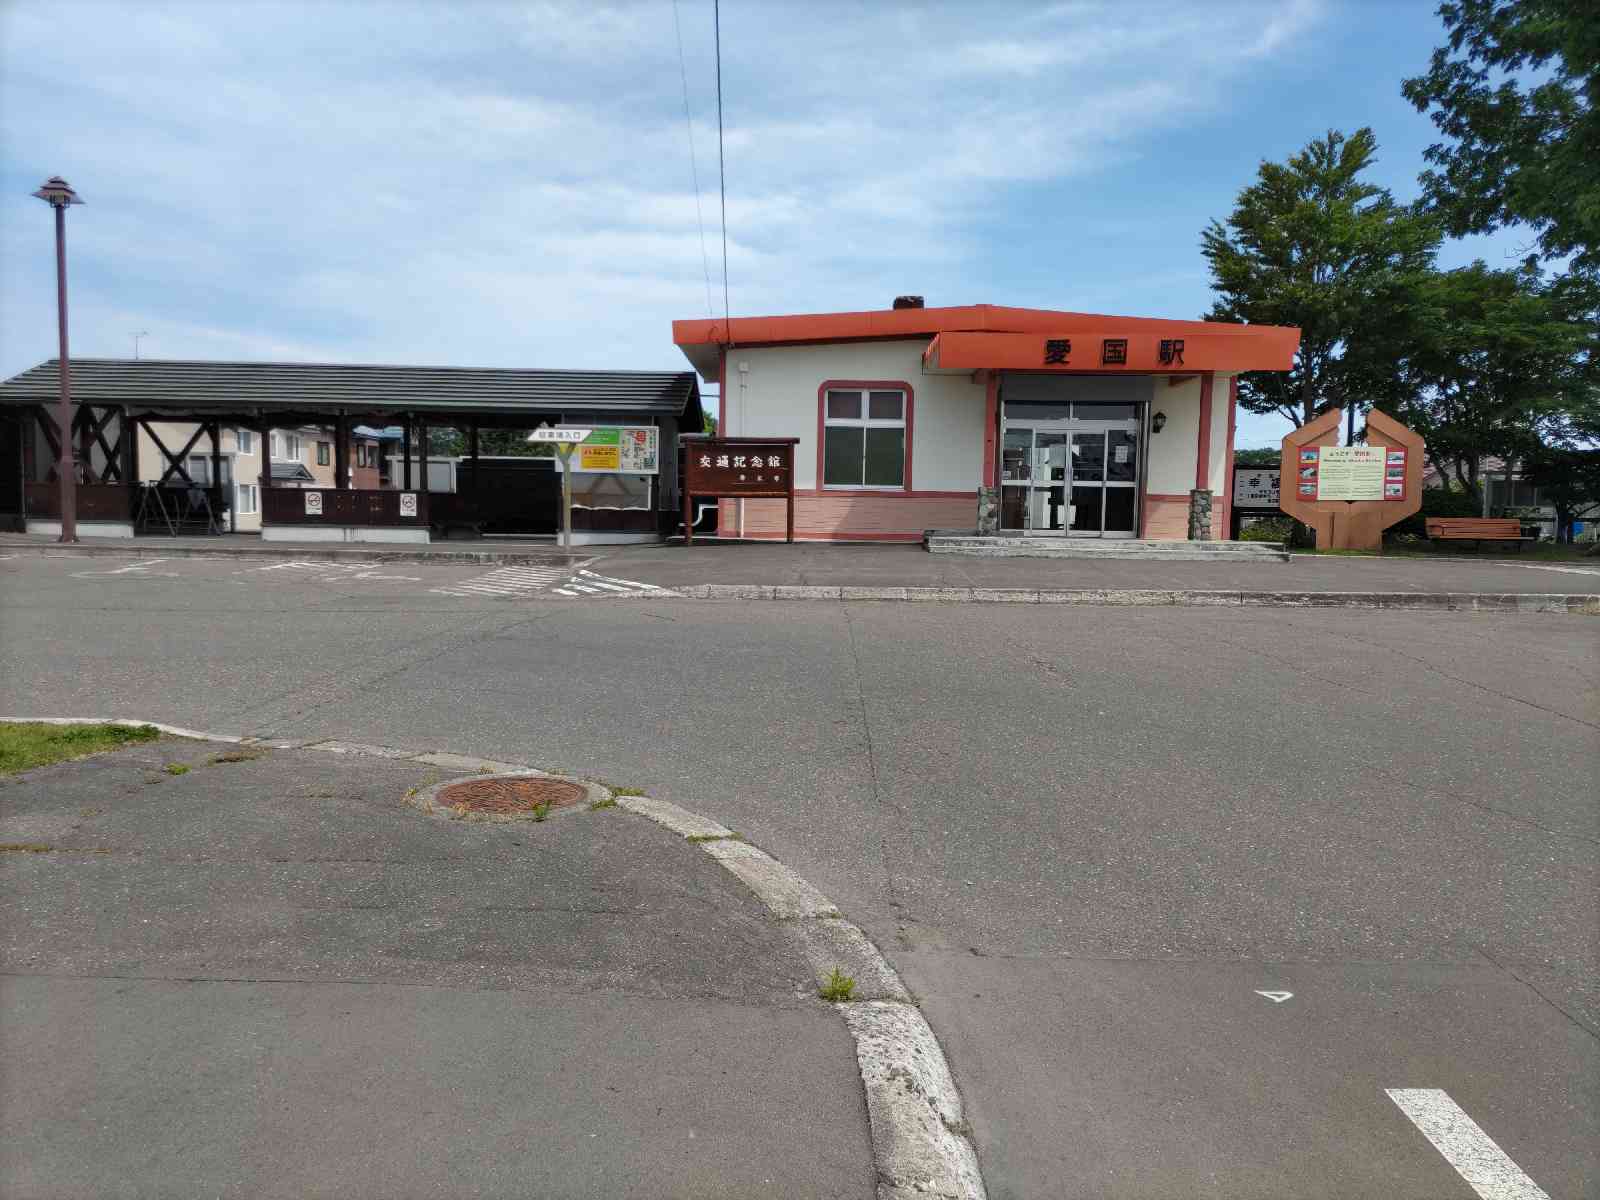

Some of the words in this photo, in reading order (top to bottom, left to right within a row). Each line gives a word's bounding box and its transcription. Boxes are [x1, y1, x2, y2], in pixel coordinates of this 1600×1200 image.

[1045, 339, 1184, 365] 愛国駅
[538, 431, 582, 441] 駐車場入口
[699, 455, 782, 468] 交通記念館
